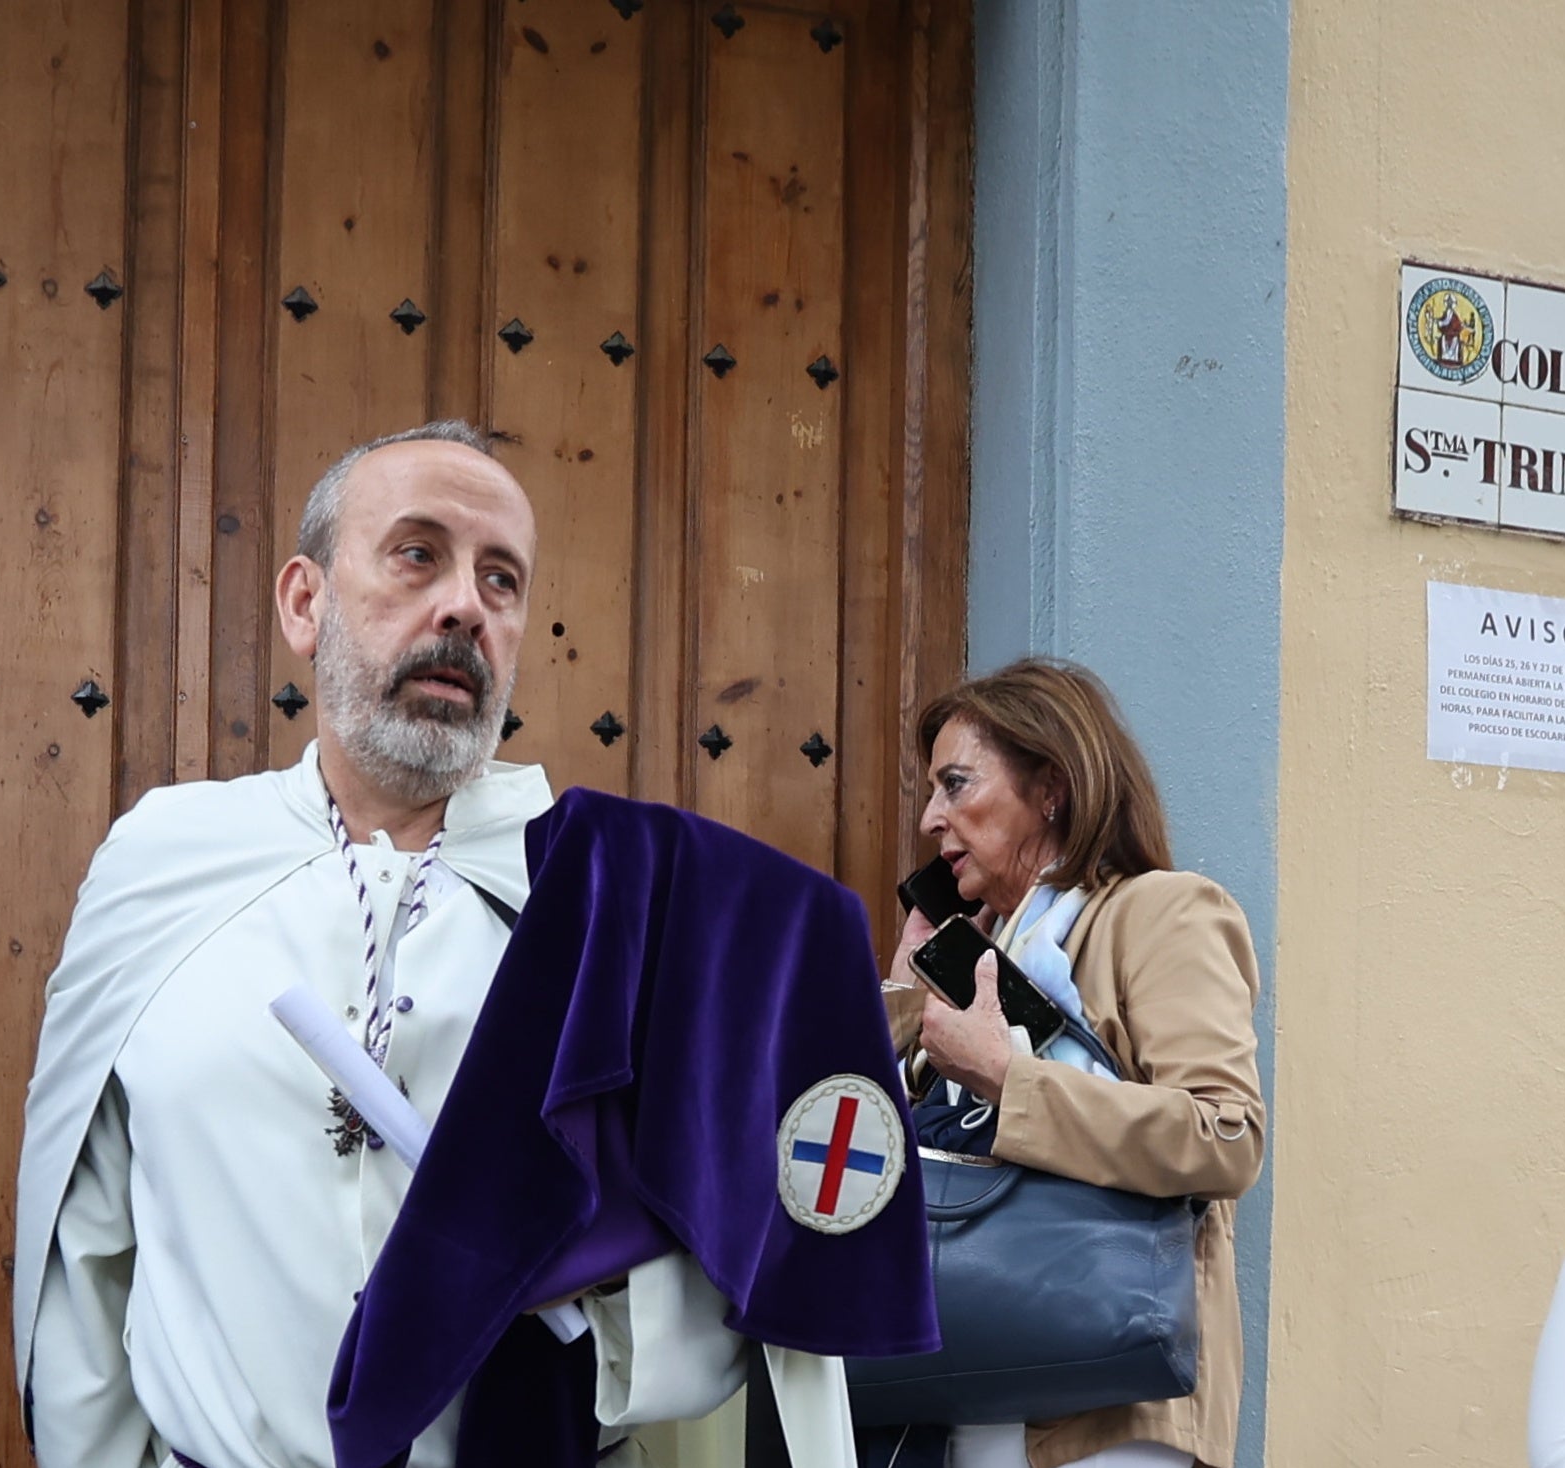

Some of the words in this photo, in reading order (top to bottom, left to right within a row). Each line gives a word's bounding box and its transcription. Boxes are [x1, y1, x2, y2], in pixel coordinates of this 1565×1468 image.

[1464, 654, 1480, 665] LOS
[1482, 655, 1503, 667] DÍAS
[1505, 659, 1518, 670] 25,
[1520, 661, 1530, 671] 26
[1532, 662, 1538, 670] Y
[1540, 663, 1550, 672] 27
[1552, 665, 1563, 675] DE
[1448, 669, 1513, 685] PERMANECERÁ
[1515, 677, 1551, 689] ABIERTA
[1553, 682, 1563, 691] LA
[1440, 685, 1456, 695] DEL
[1458, 687, 1497, 700] COLEGIO
[1499, 692, 1510, 702] EN
[1512, 694, 1552, 707] HORARIO
[1554, 698, 1565, 708] DE
[1476, 707, 1500, 717] PARA
[1502, 709, 1545, 723] FACILITAR
[1547, 715, 1553, 724] A
[1468, 723, 1509, 735] PROCESO
[1511, 727, 1523, 737] DE
